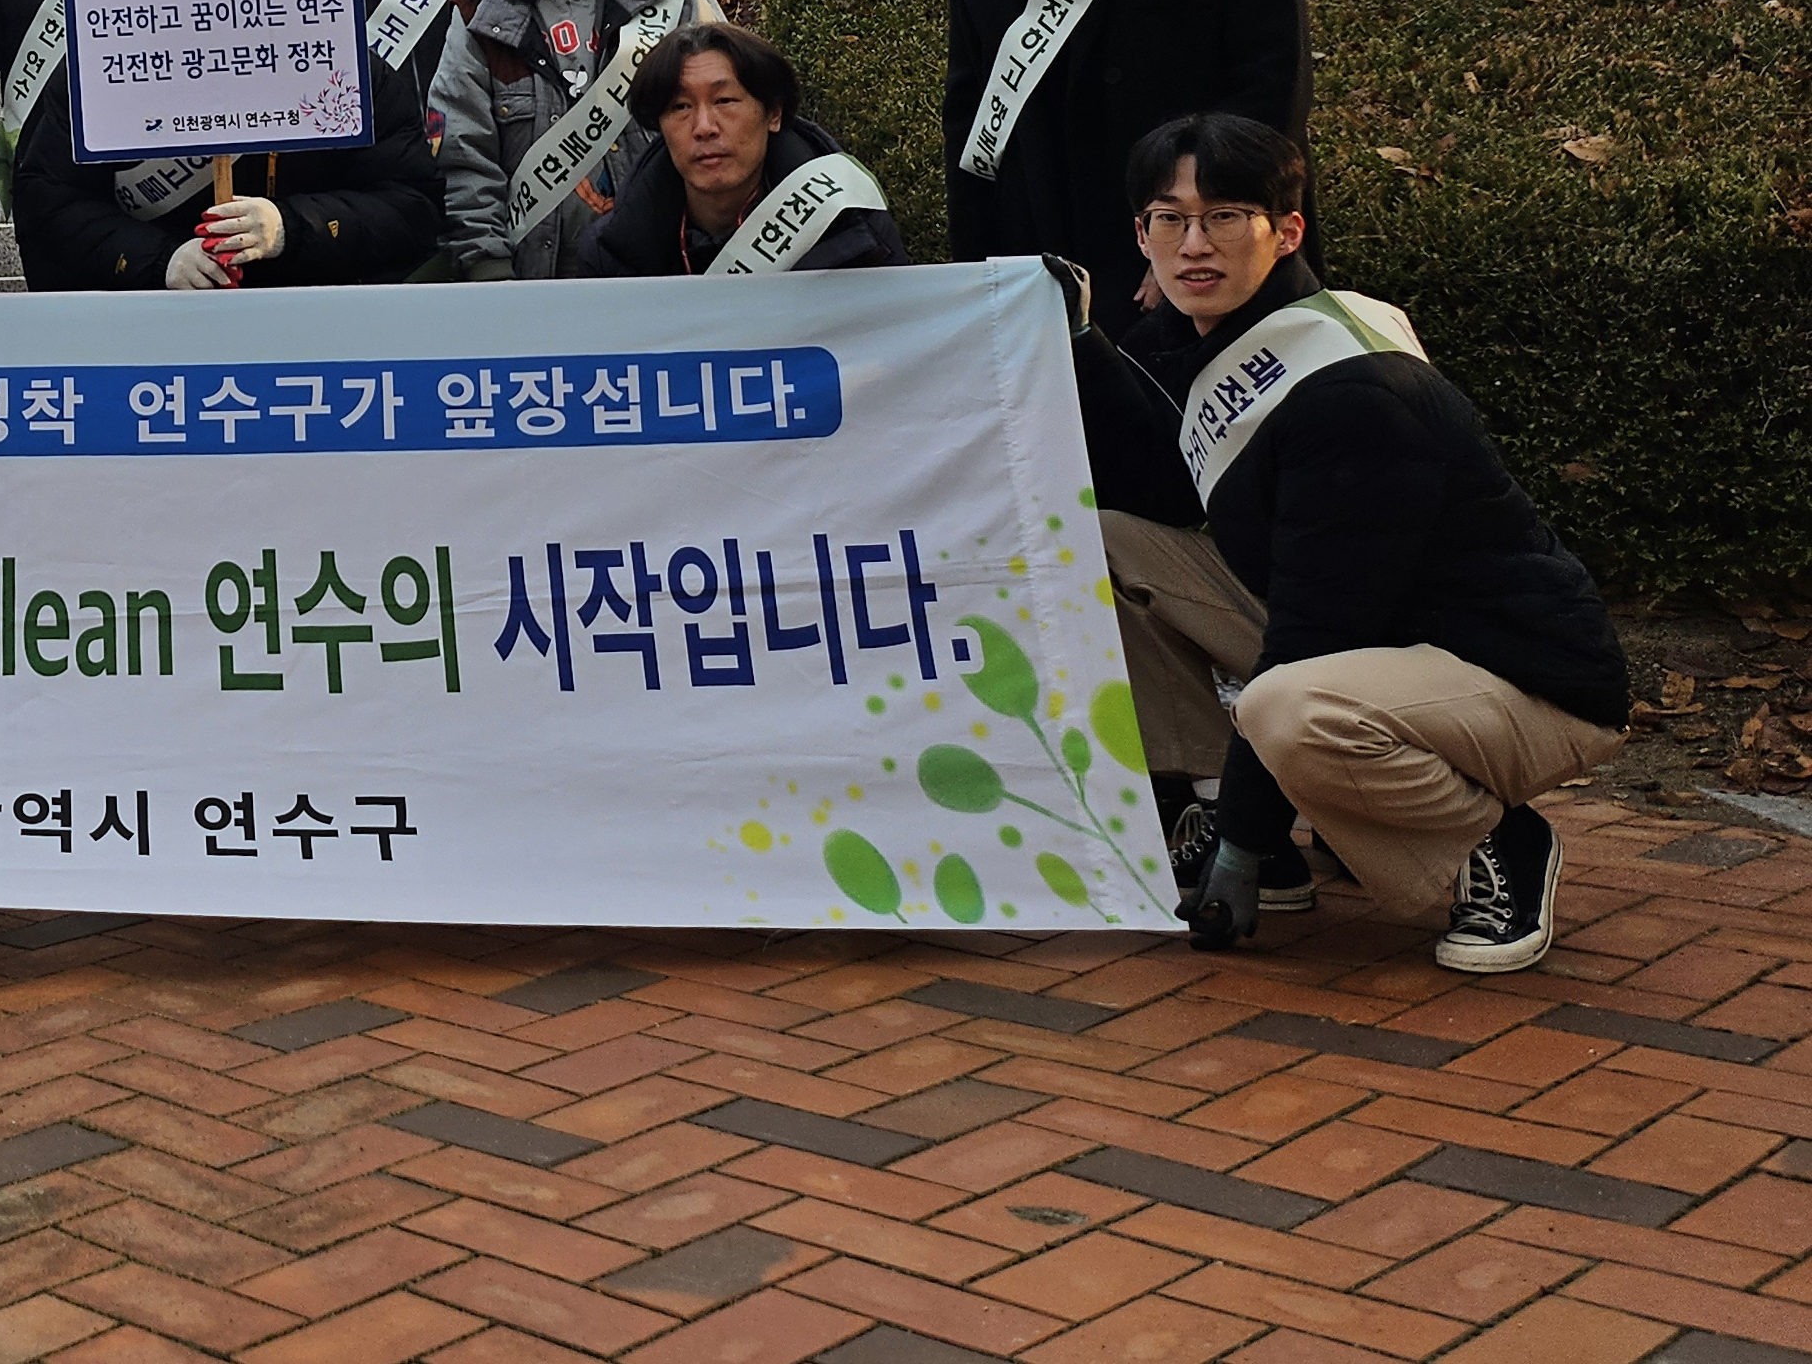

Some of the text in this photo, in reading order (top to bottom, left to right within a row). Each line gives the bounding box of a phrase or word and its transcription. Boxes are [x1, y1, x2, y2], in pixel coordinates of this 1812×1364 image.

[87, 5, 183, 38] 안전하고
[369, 13, 409, 61] 도시
[13, 50, 46, 101] 연수
[102, 39, 336, 84] 건전한 광고문화 정착
[172, 109, 300, 132] 인천광역시 연수구청
[533, 105, 612, 191] 행복한
[751, 172, 844, 264] 건전한
[128, 372, 405, 443] 연수구가
[437, 358, 808, 439] 앞장섭니다.
[1198, 347, 1287, 445] 쾌적한
[204, 545, 461, 694] 연수의
[494, 528, 972, 692] 시작입니다.
[193, 789, 419, 861] 연수구
